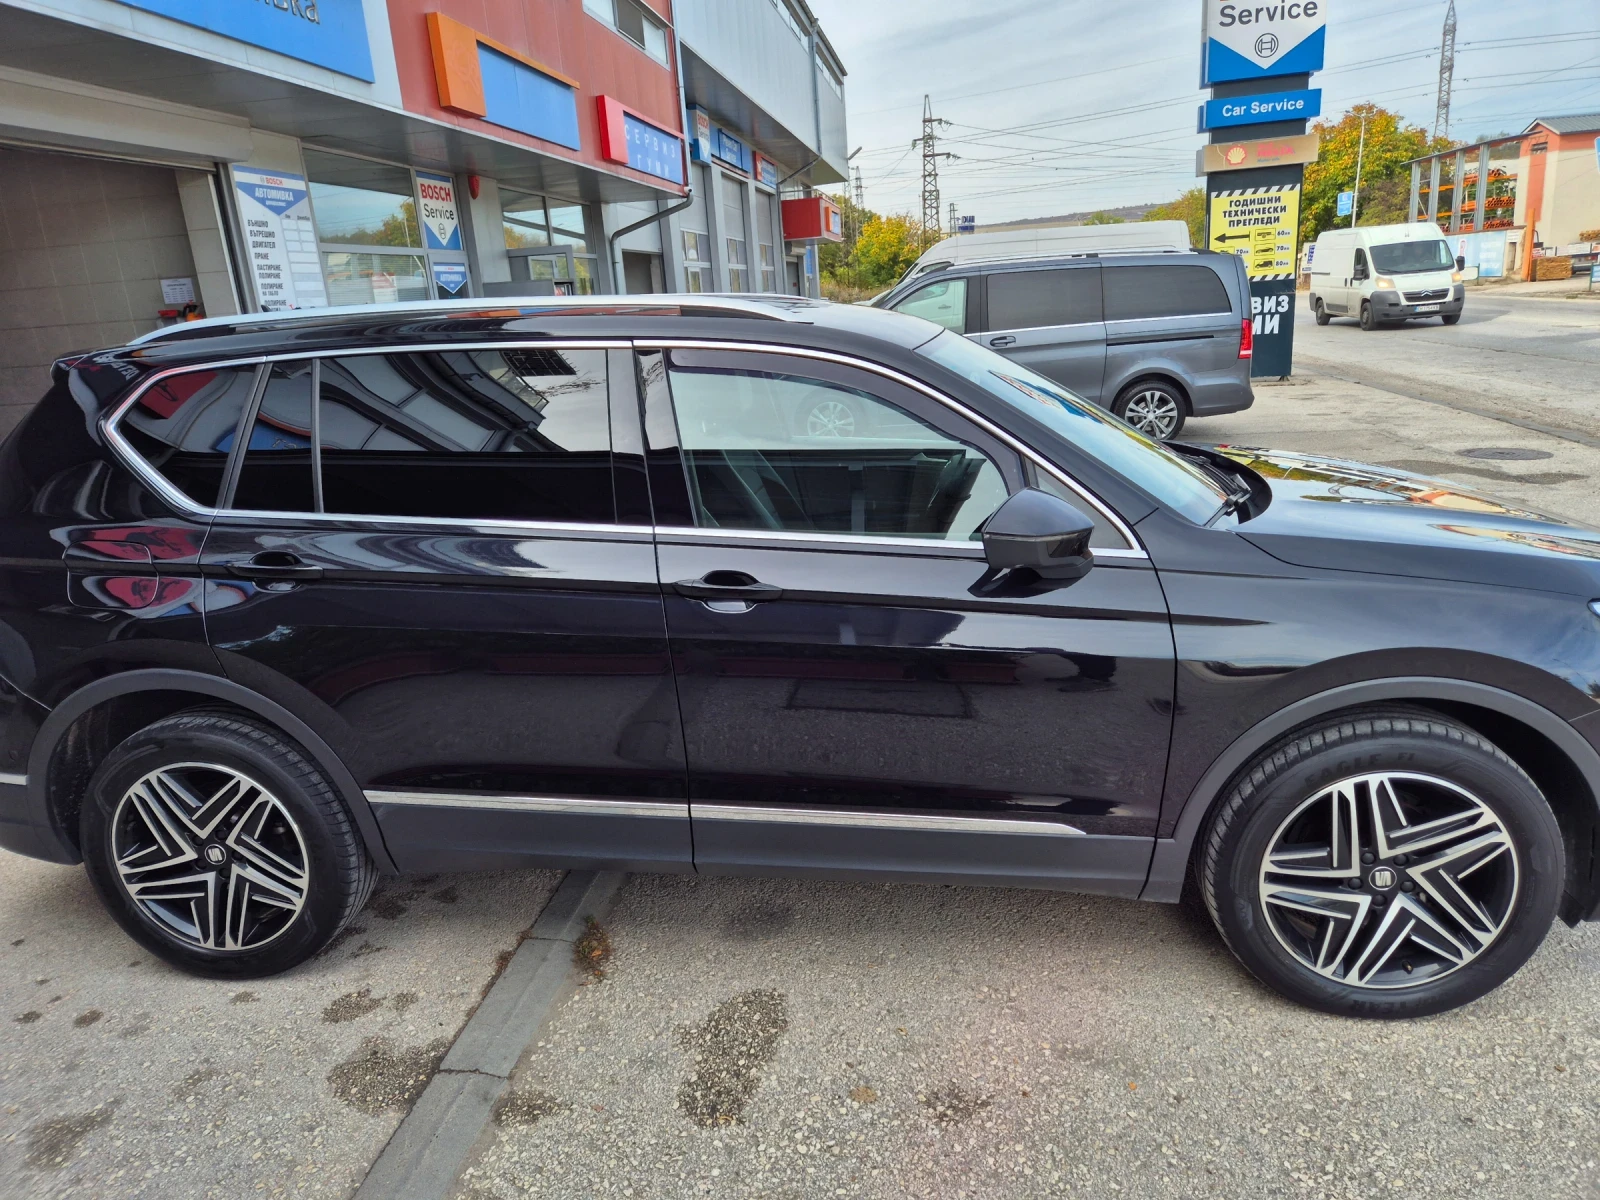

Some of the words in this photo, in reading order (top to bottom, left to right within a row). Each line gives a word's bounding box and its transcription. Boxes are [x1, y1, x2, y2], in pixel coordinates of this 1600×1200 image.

[1219, 0, 1318, 27] Service
[1222, 104, 1247, 117] Car
[1250, 99, 1304, 114] Service
[624, 123, 676, 158] СЕРВИЗ
[637, 154, 669, 178] ГУМИ
[265, 177, 283, 186] BOSCH
[255, 187, 294, 201] АВТОМИВКА
[420, 183, 452, 202] BOSCH
[1229, 195, 1281, 208] ГОДИШНИ
[423, 203, 455, 220] Service
[1222, 205, 1287, 218] ТЕХНИЧЕСКИ
[248, 219, 268, 228] ВЪНШНО
[1228, 216, 1280, 228] ПРЕГЛЕДИ
[250, 229, 275, 239] ВЪТРЕШНО
[252, 240, 276, 249] ДВИГАТЕЛ
[254, 252, 269, 260] ПРАНЕ
[1250, 294, 1290, 314] ВИЗ
[1304, 753, 1382, 784] EAGLE
